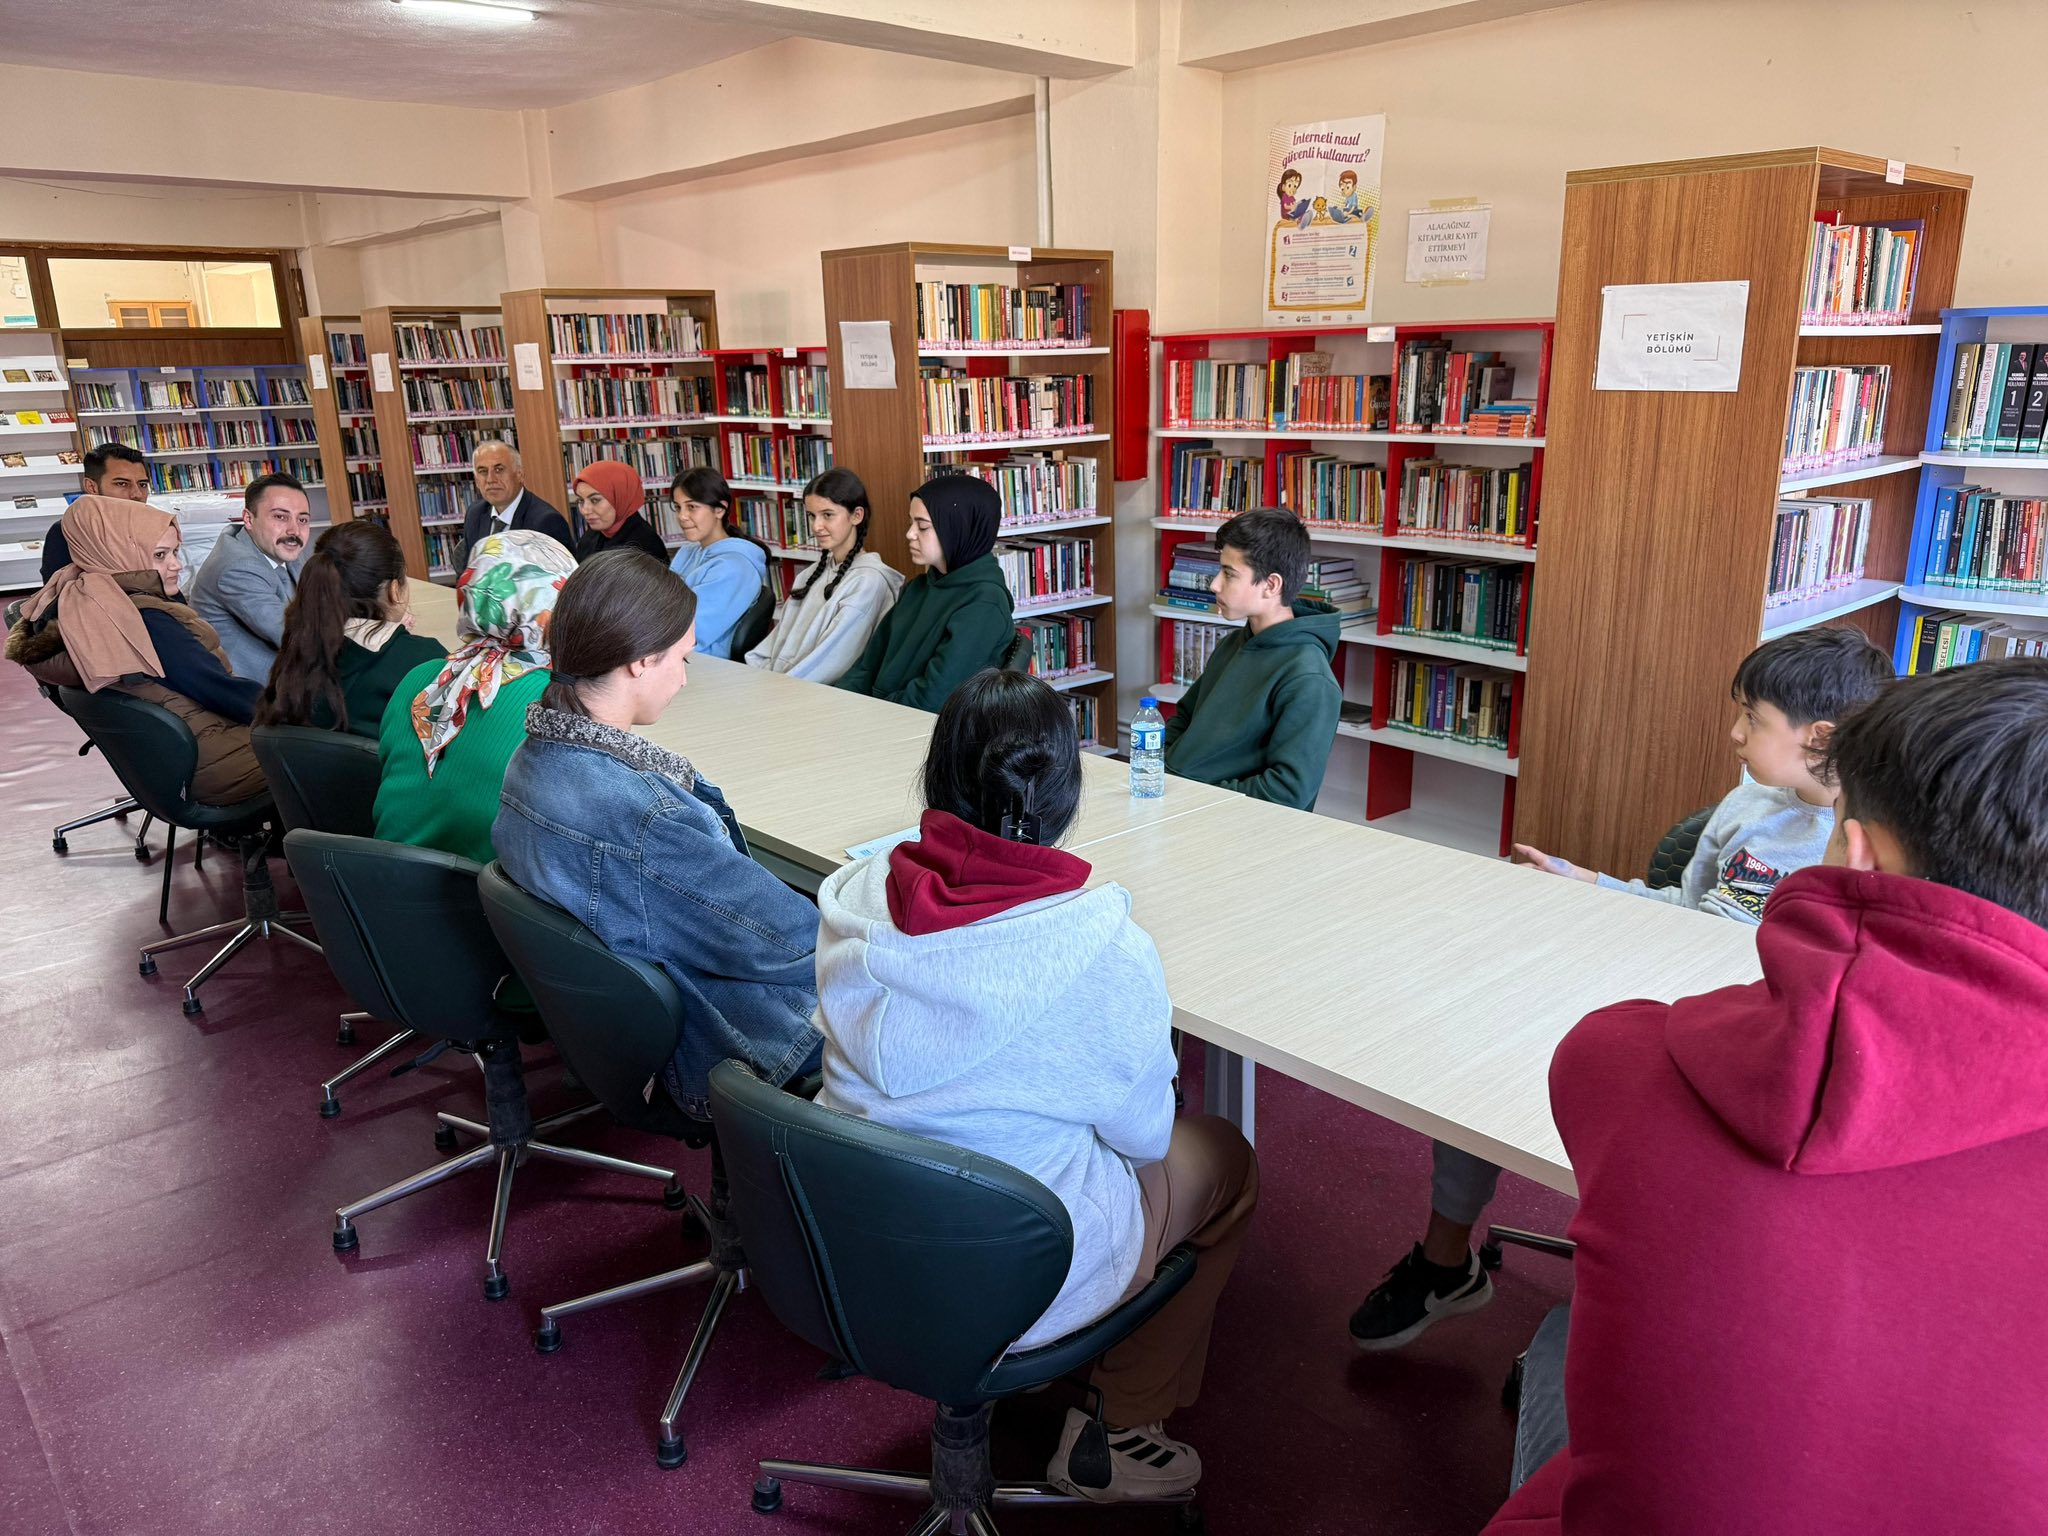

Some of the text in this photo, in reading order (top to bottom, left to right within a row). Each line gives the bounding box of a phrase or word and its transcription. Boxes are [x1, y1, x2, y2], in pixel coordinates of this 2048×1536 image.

[1334, 132, 1361, 146] nasıl
[1282, 146, 1370, 169] güvenli kullanırız?
[1427, 220, 1471, 231] ALACAĞINIZ
[1417, 231, 1478, 242] KİTAPLARI KAYIT
[1428, 242, 1466, 252] ETTİRMEYİ
[1424, 254, 1468, 263] UNUTMAYIN
[1646, 331, 1694, 343] YETİŞKİN
[1646, 344, 1692, 354] BÖLÜMÜ
[2011, 390, 2017, 406] 1
[2032, 391, 2043, 407] 2
[1745, 856, 1768, 873] 1980
